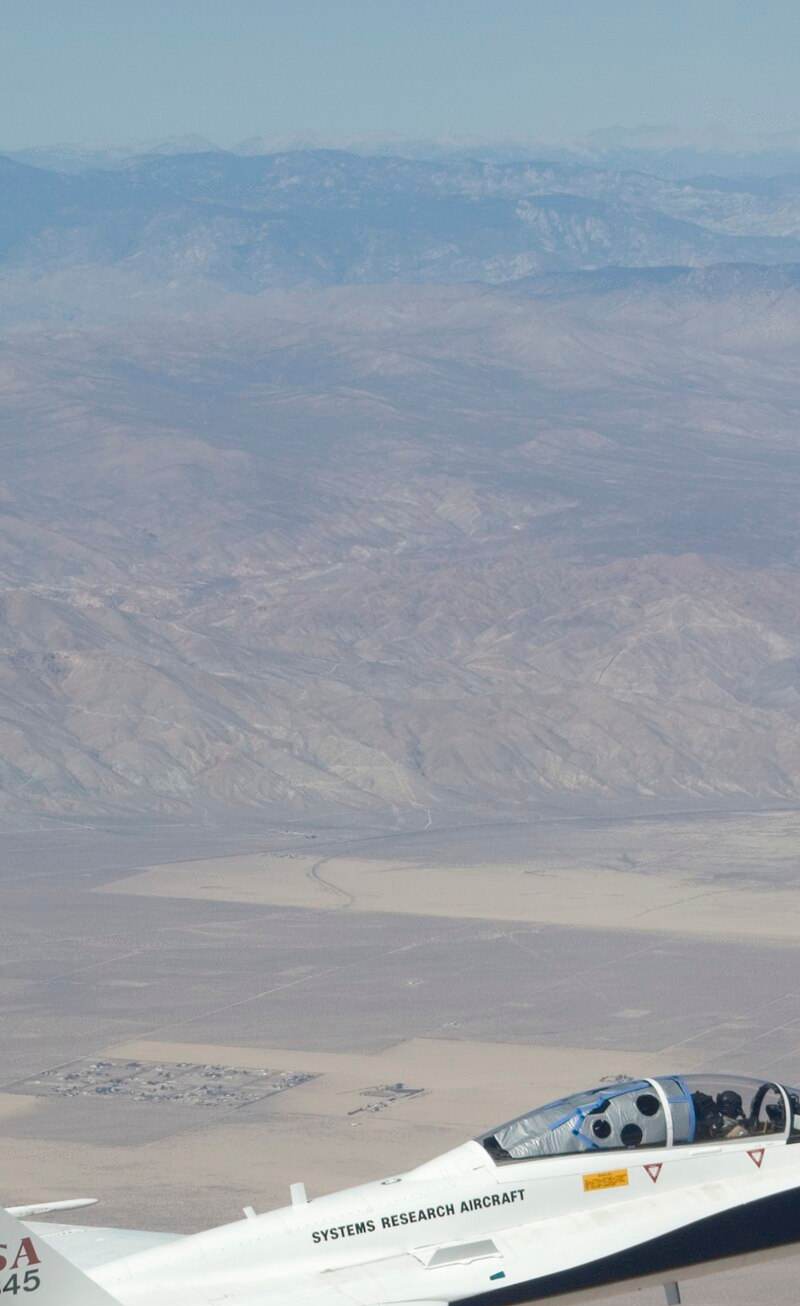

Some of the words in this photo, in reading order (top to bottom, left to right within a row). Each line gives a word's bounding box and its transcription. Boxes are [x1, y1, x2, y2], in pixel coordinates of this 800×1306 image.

[312, 1220, 376, 1244] SYSTEMS
[381, 1203, 455, 1229] RESEARCH
[460, 1188, 526, 1214] AIRCRAFT
[0, 1269, 40, 1295] 45
